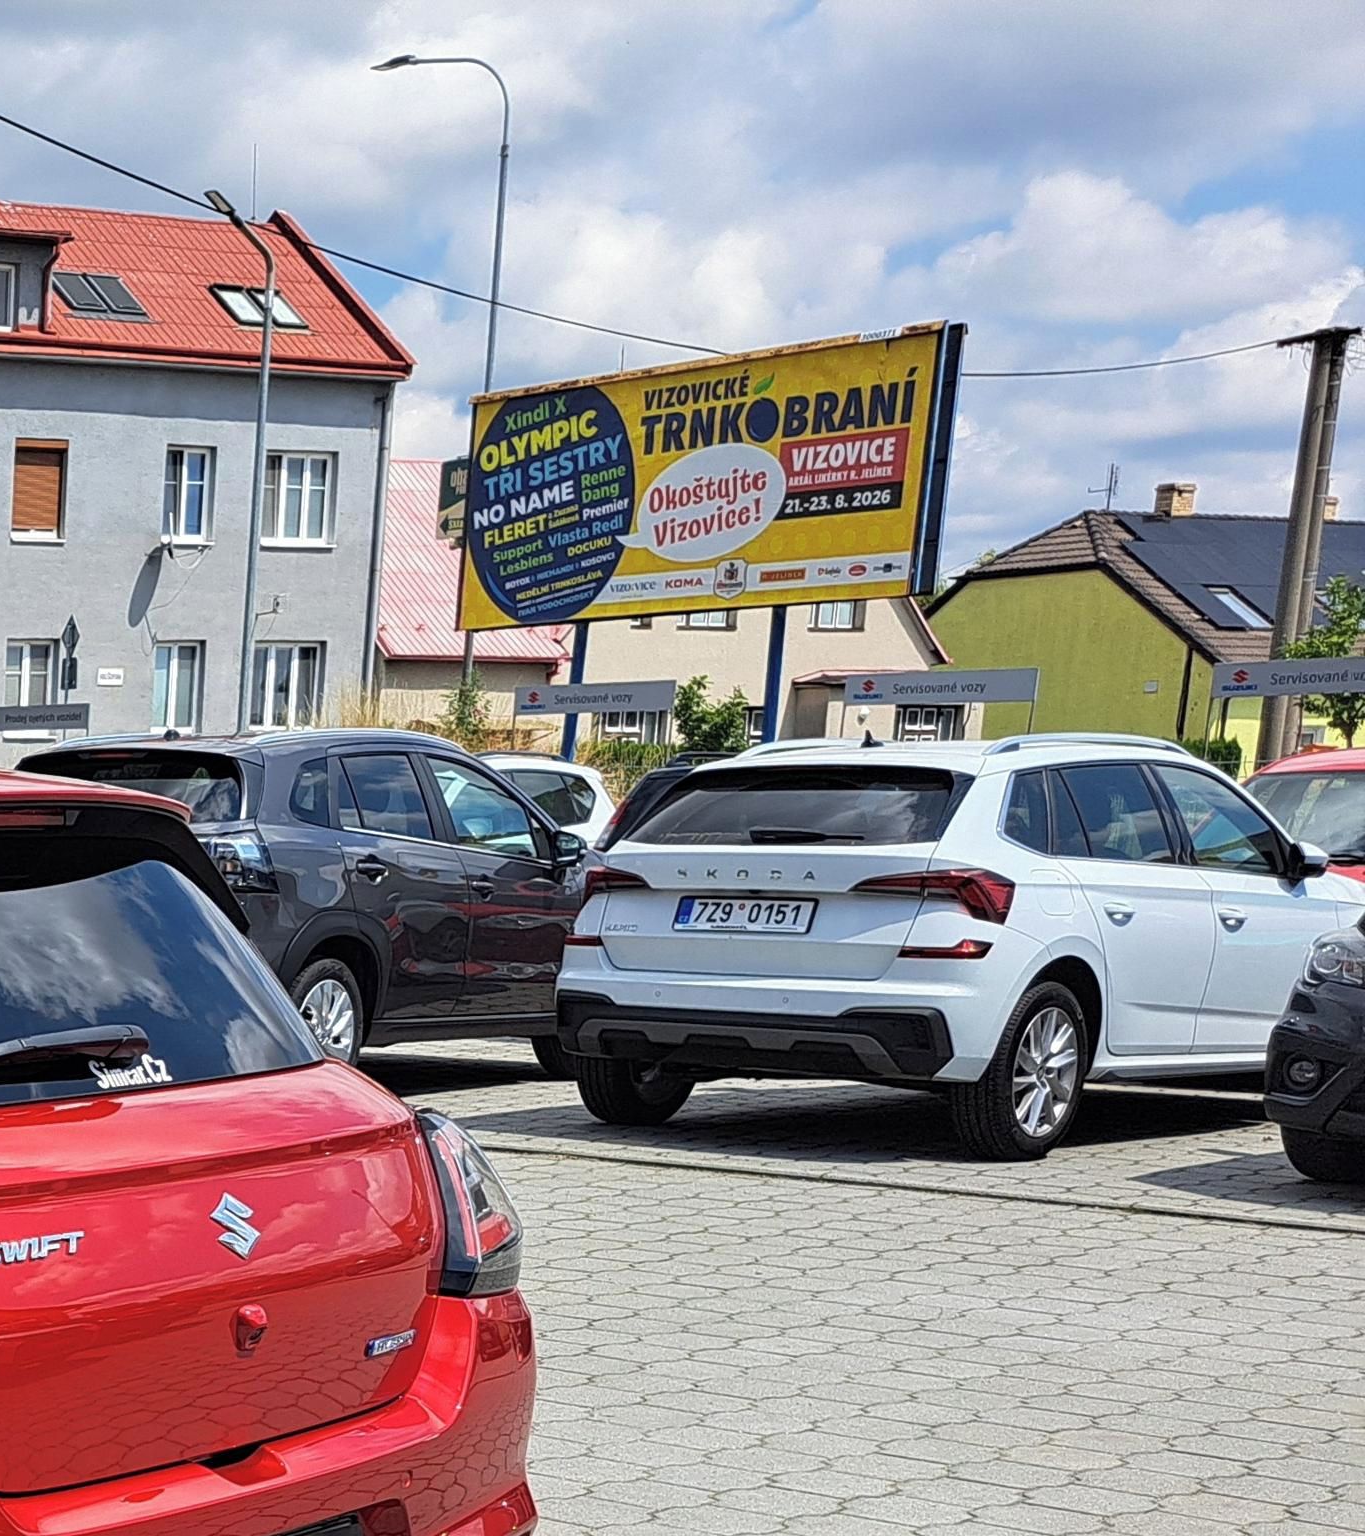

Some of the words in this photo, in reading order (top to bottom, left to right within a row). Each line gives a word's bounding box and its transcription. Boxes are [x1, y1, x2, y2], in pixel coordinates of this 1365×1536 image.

[644, 369, 750, 411] VIZOVICKÉ
[504, 401, 550, 433] Xindl
[554, 395, 567, 416] X
[640, 366, 918, 456] TRNKOBRANÍ
[479, 409, 598, 472] OLYMPIC
[483, 466, 523, 501] TŘI
[528, 433, 624, 487] SESTRY
[791, 437, 897, 472] VIZOVICE
[581, 465, 627, 489] Renne
[582, 483, 620, 503] Dang
[649, 467, 767, 514] Okoštujte
[835, 494, 848, 509] 8.
[852, 489, 891, 508] 2026
[473, 504, 505, 530] NO
[510, 481, 575, 518] NAME
[582, 498, 629, 521] Premier
[484, 514, 547, 549] FLERET
[548, 526, 589, 548] Vlasta
[592, 515, 624, 536] Redl
[653, 497, 762, 548] Vizovice!
[493, 539, 544, 564] Support
[567, 536, 613, 557] DOCUKU
[500, 553, 554, 576] Lesbiens
[664, 577, 704, 590] KOMA
[893, 682, 957, 695] Servisované
[961, 683, 986, 694] vozy
[1222, 684, 1257, 692] SUZUKI
[1270, 669, 1349, 686] Servisované
[554, 693, 609, 705] Servisované
[612, 694, 634, 704] vozy
[694, 902, 734, 922] 7Z9
[747, 903, 802, 925] 0151
[88, 1054, 173, 1089] Simcar.Cz
